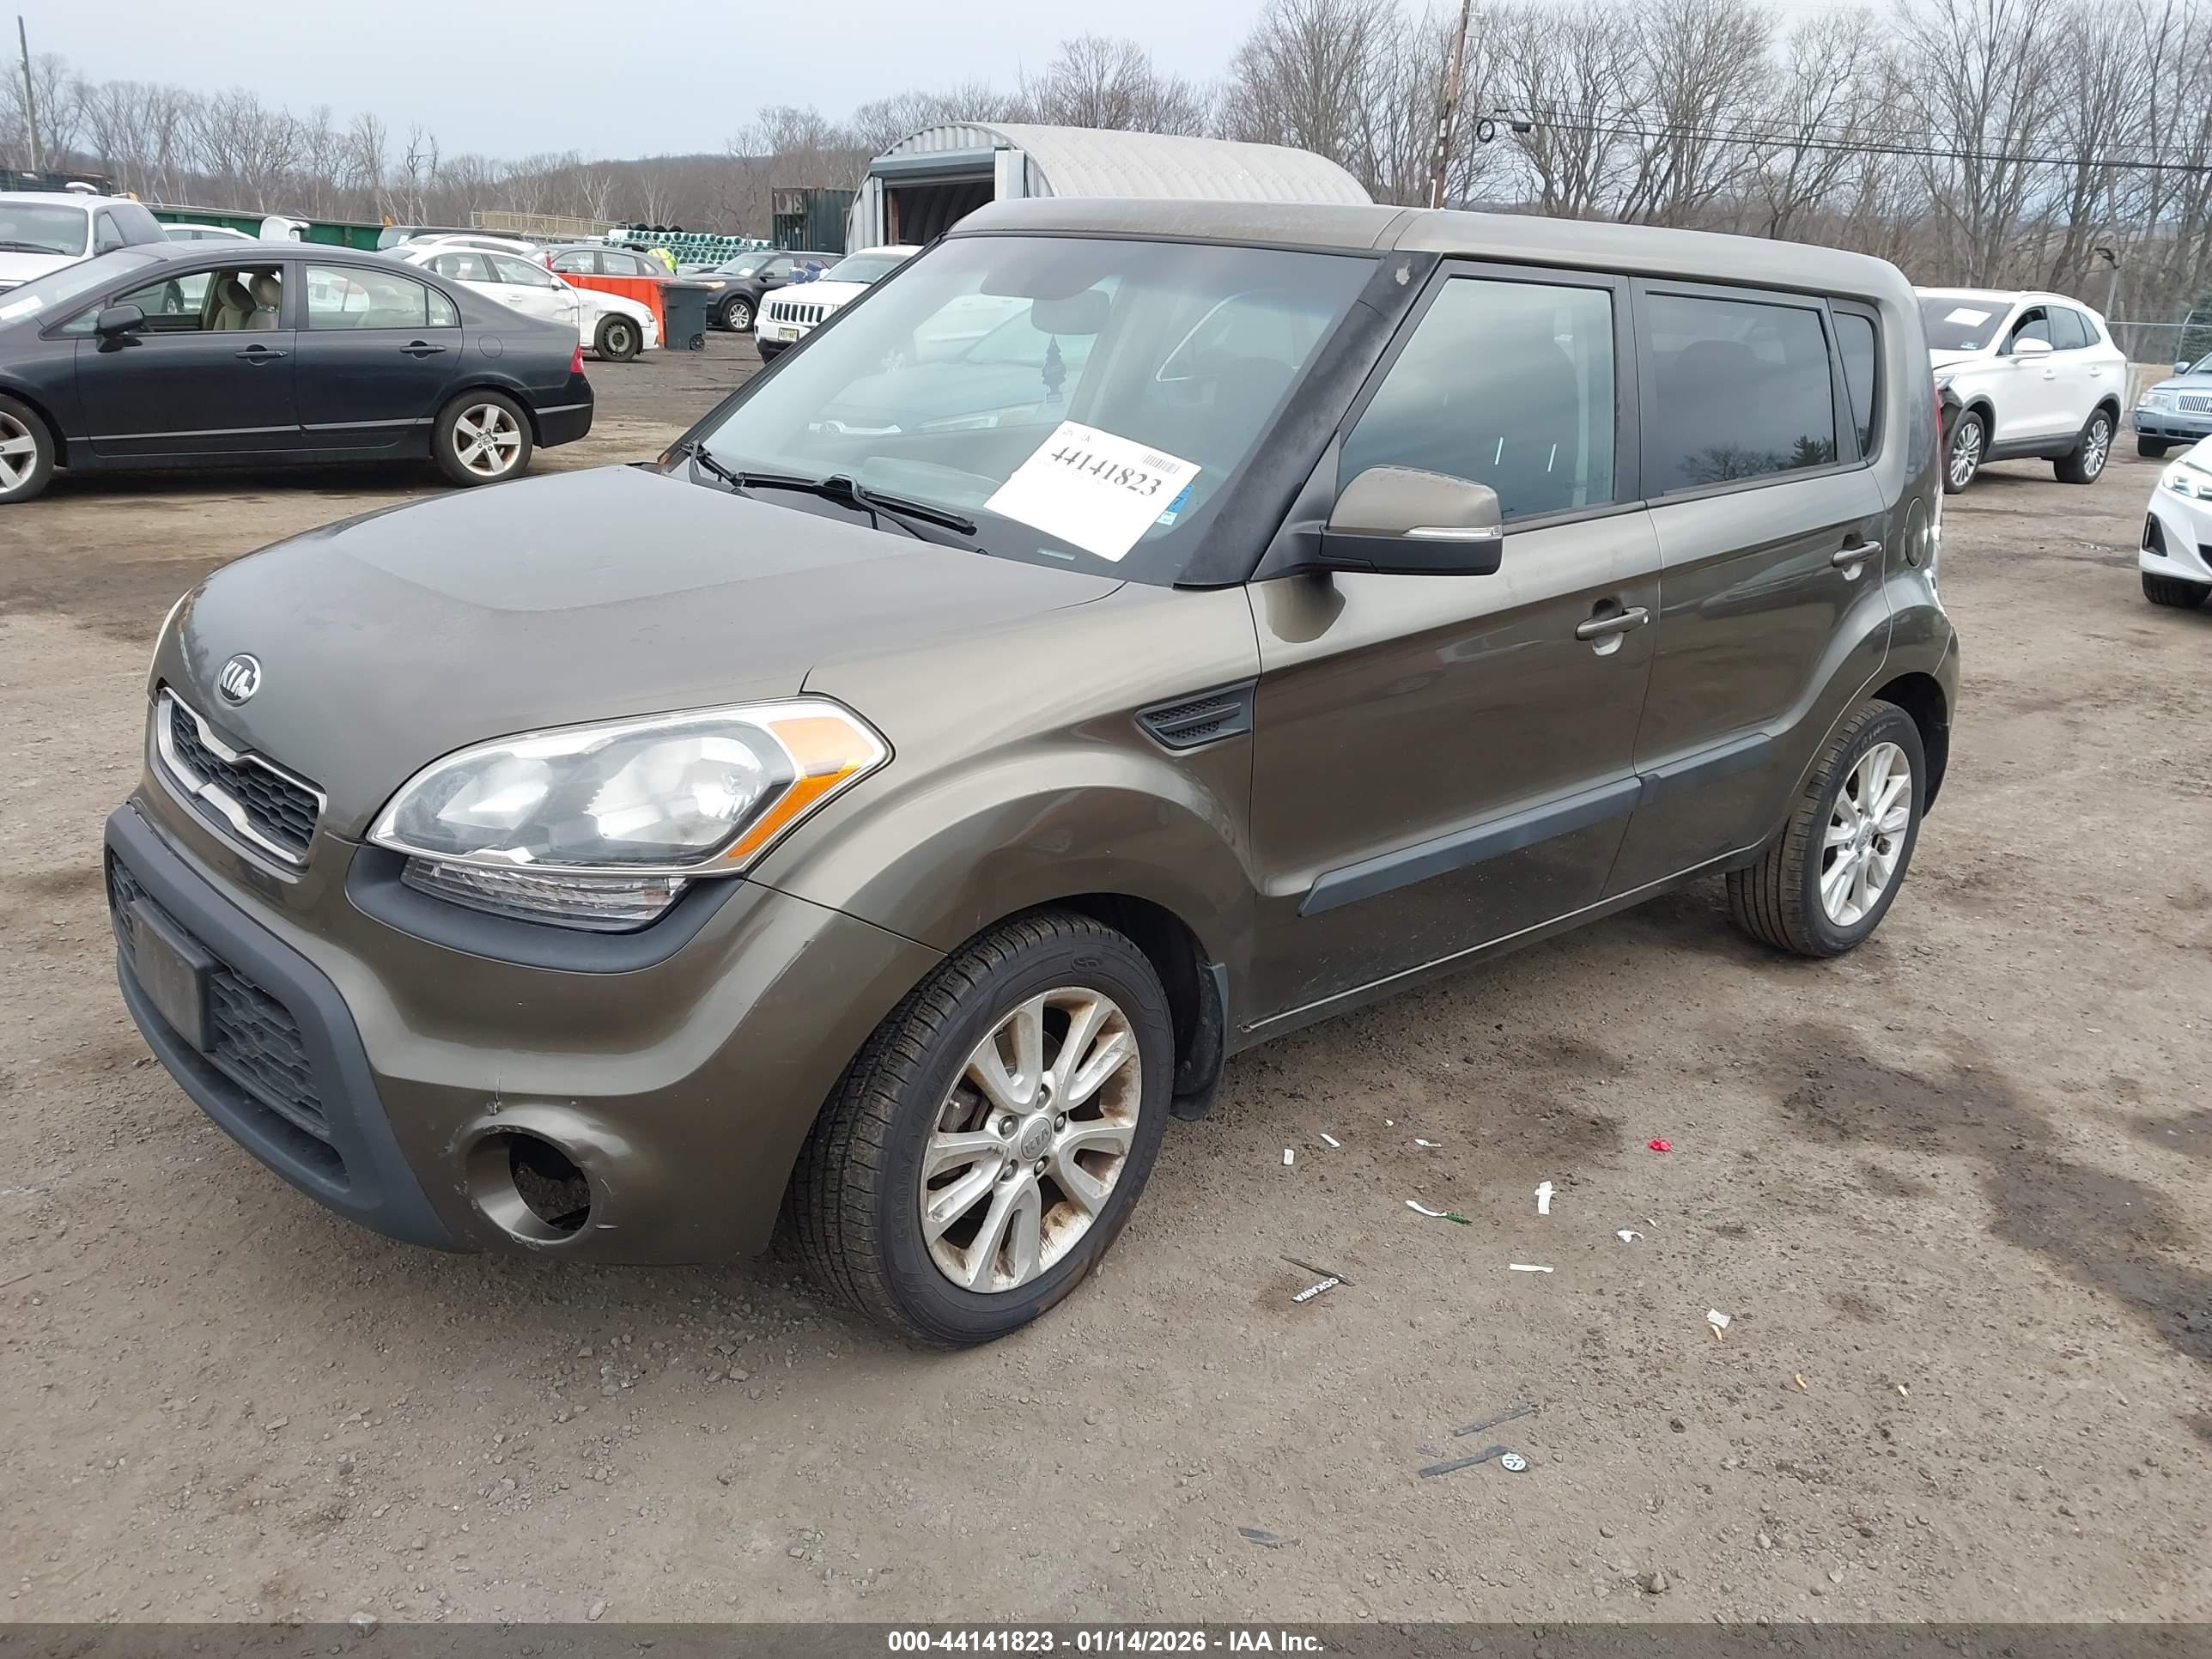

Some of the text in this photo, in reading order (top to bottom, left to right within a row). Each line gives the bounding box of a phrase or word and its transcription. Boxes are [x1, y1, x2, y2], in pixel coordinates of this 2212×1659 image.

[1050, 445, 1163, 497] 44141823
[220, 659, 251, 697] KIA
[1024, 1125, 1050, 1155] KIA
[1291, 1273, 1346, 1303] OCKAWA
